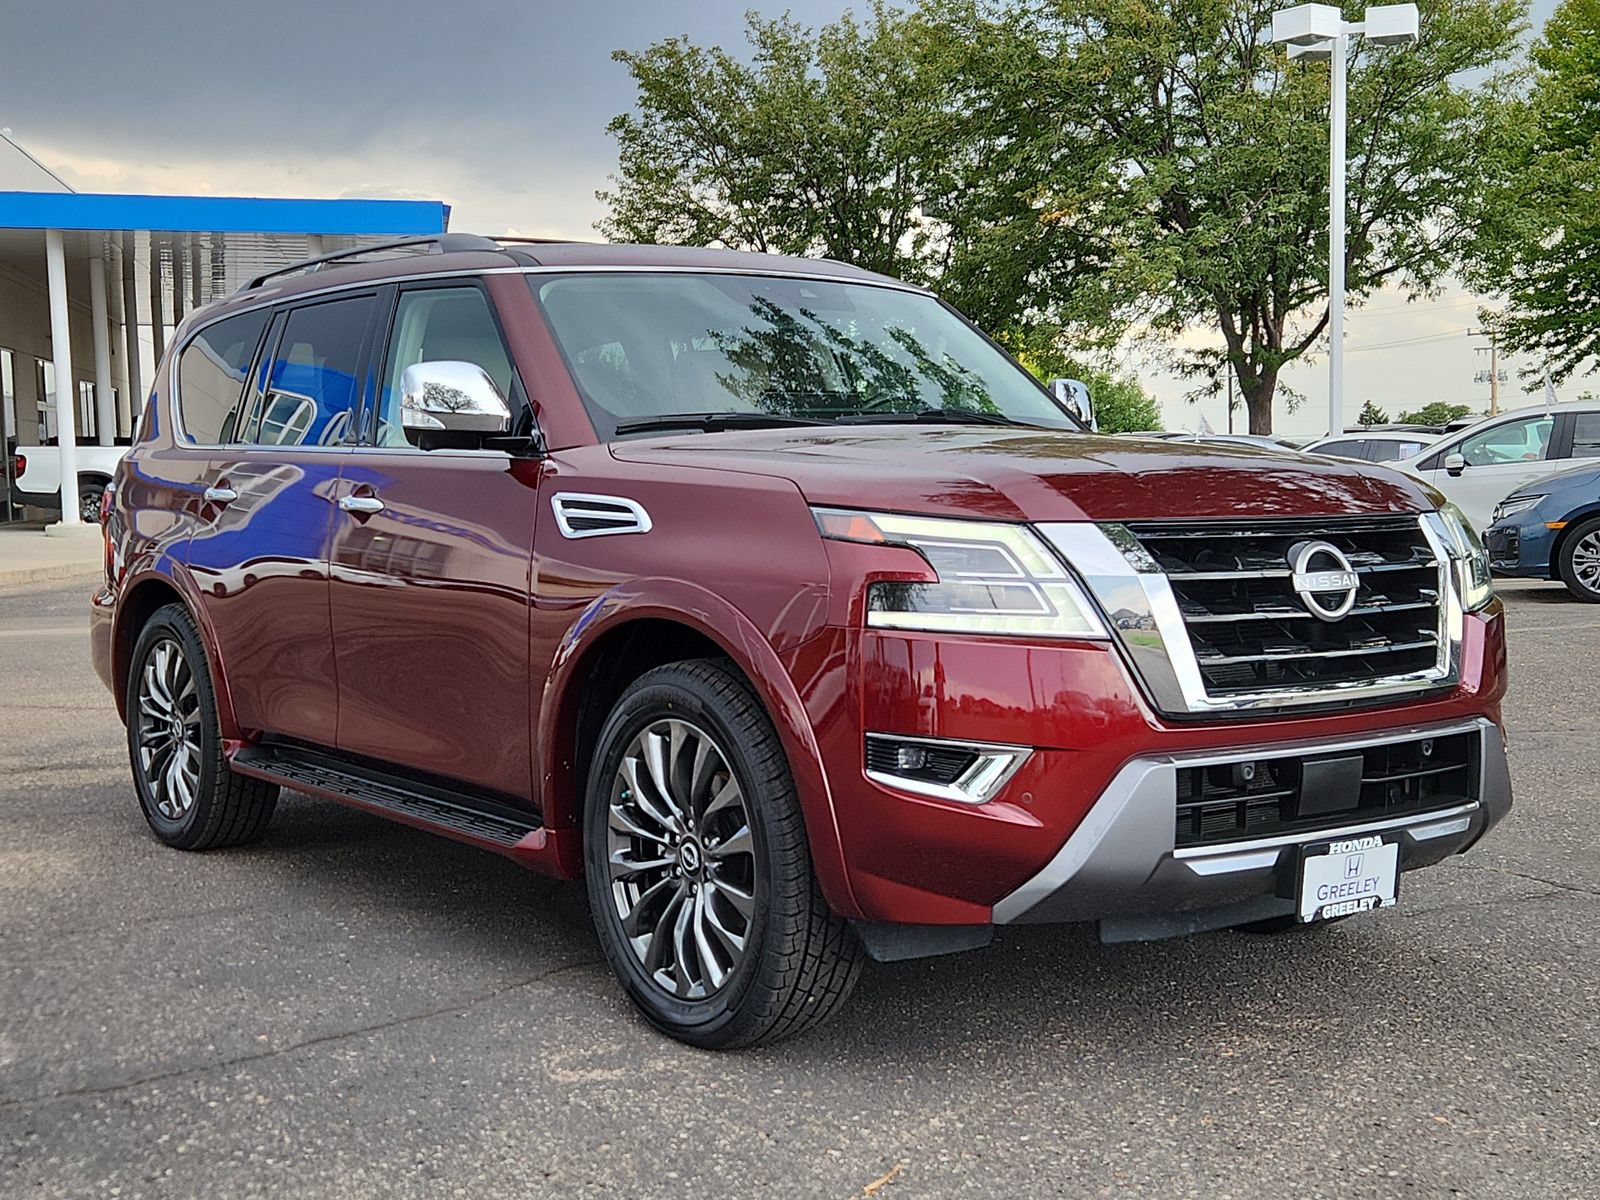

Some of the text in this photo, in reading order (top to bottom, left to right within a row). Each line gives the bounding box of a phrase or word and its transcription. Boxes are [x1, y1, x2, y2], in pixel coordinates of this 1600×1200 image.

[1297, 574, 1359, 588] NISSAN
[1329, 835, 1383, 855] HONDA
[1317, 876, 1380, 901] GREELEY
[1322, 896, 1376, 919] GREELEY
